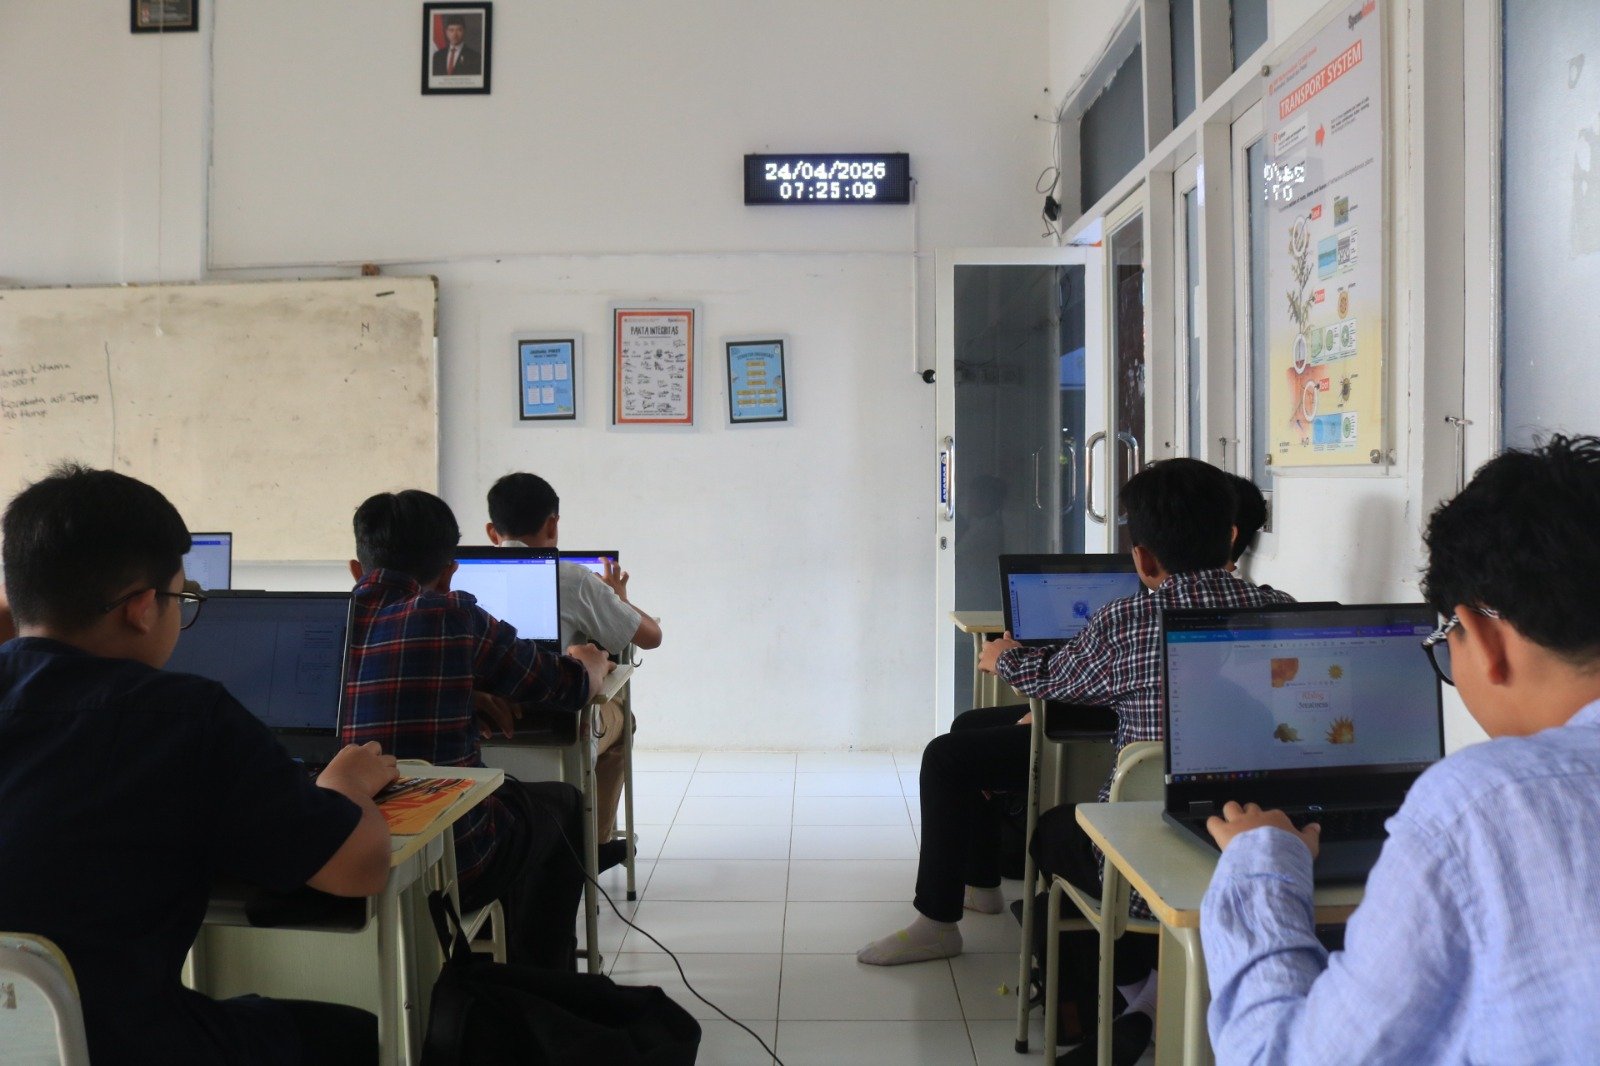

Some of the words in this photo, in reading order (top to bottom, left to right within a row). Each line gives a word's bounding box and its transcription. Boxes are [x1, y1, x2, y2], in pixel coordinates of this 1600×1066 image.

[1281, 71, 1326, 118] TRANSPORT
[1327, 42, 1362, 86] SYSTEM
[765, 160, 886, 180] 24/04/2026
[780, 182, 876, 199] 07:25:09
